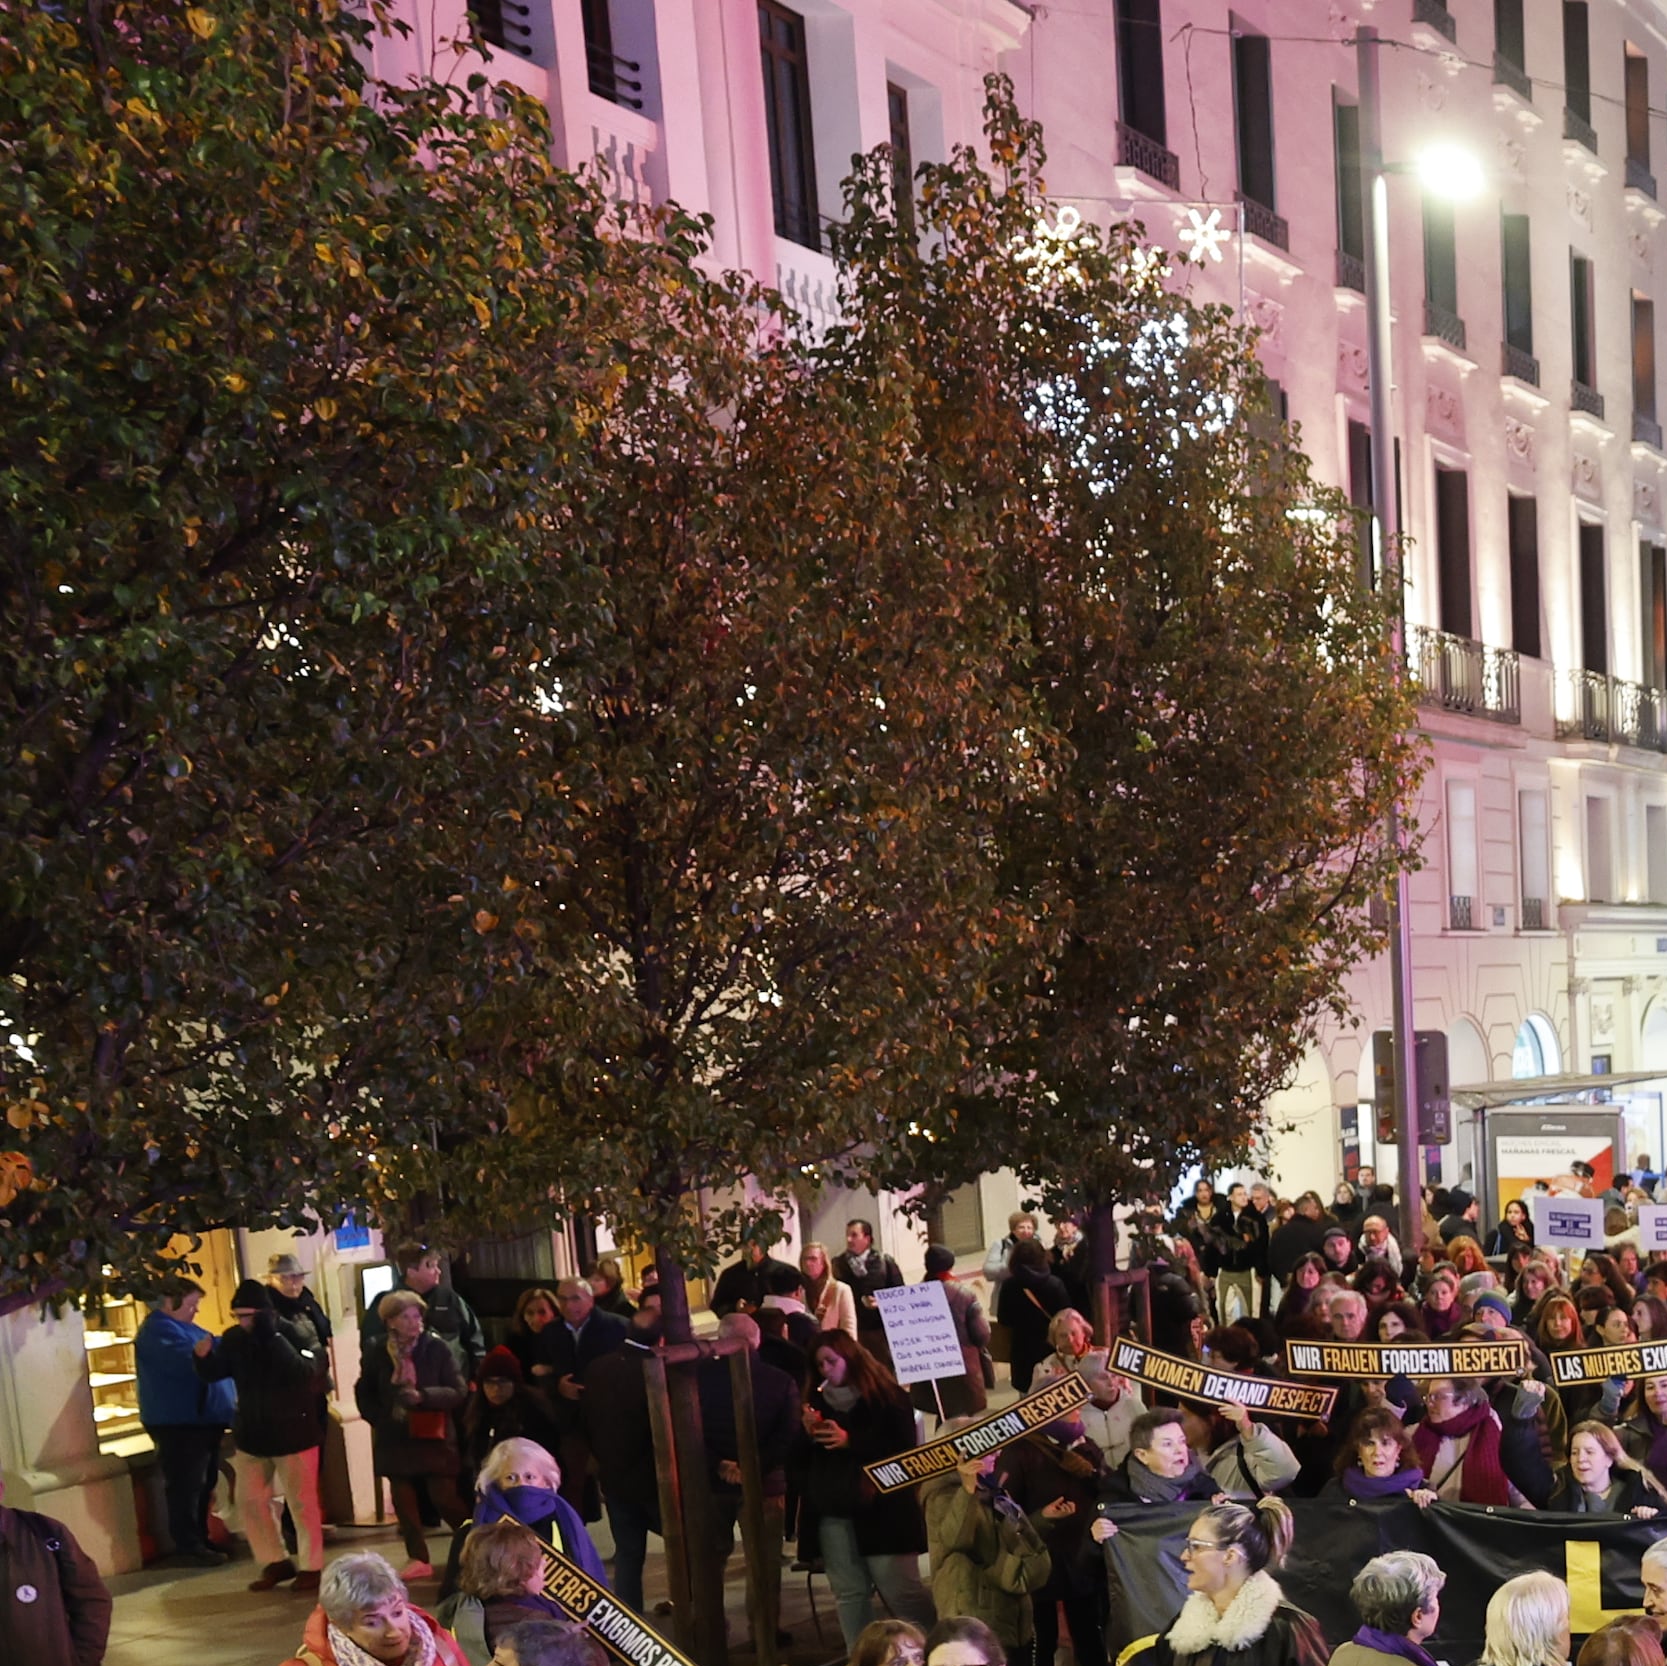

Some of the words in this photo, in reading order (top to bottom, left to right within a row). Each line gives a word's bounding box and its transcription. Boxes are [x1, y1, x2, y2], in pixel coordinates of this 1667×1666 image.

[877, 1288, 905, 1300] EDUCO
[909, 1287, 917, 1295] A
[1292, 1344, 1322, 1371] WIR
[1323, 1345, 1380, 1373] FRAUEN
[1381, 1346, 1450, 1373] FORDERN
[1452, 1346, 1518, 1372] RESPEKT
[1557, 1355, 1583, 1380] LAS
[1584, 1347, 1642, 1378] MUJERES
[1116, 1345, 1142, 1375] WE
[1143, 1353, 1204, 1394] WOMEN
[1202, 1373, 1269, 1406] DEMAND
[1265, 1387, 1332, 1417] RESPECT
[870, 1462, 906, 1489] WIR
[901, 1442, 960, 1480] FRAUEN
[955, 1416, 1026, 1461] FORDERN
[1021, 1375, 1088, 1430] RESPEKT
